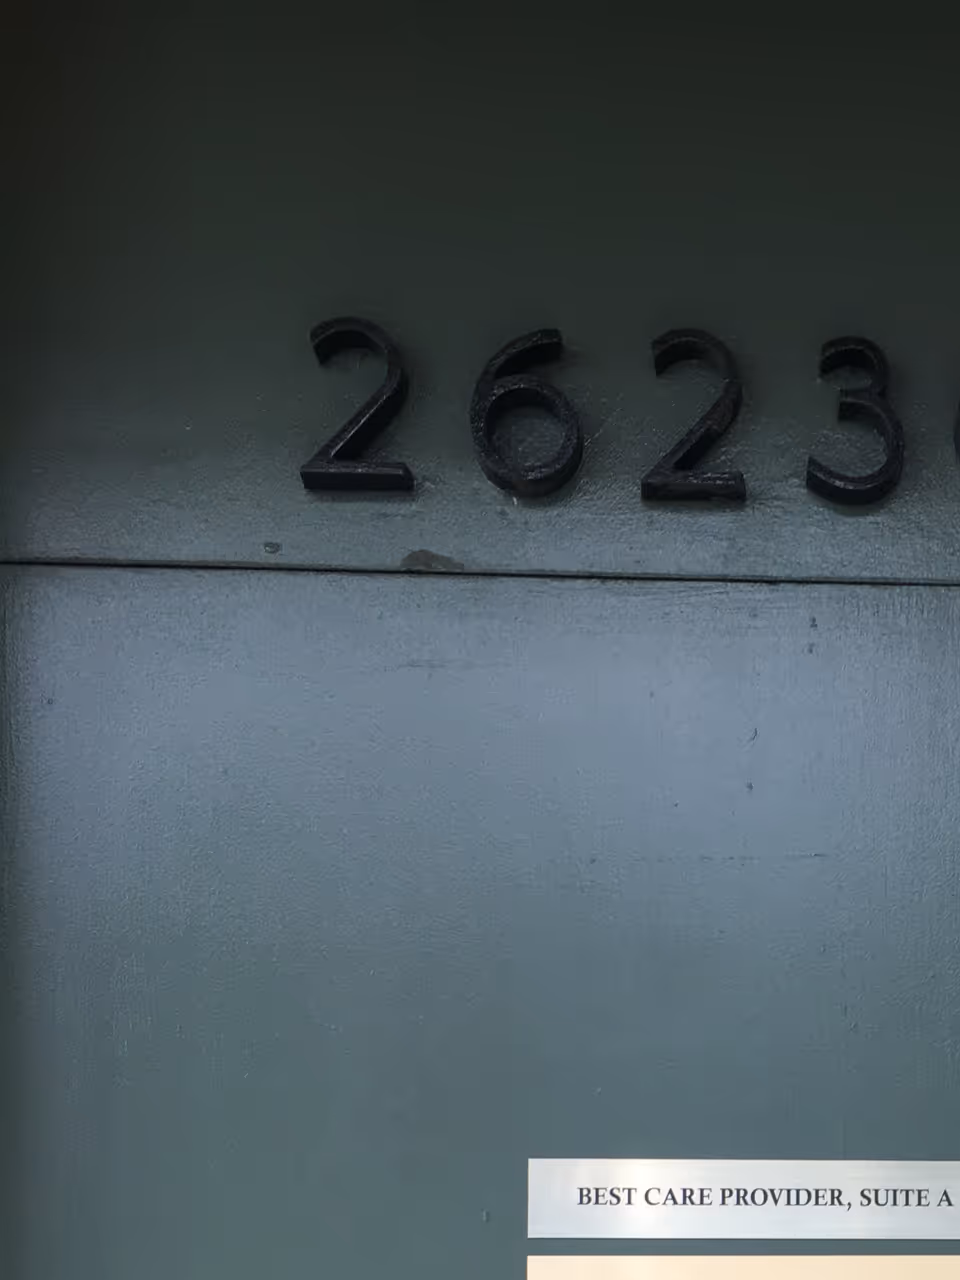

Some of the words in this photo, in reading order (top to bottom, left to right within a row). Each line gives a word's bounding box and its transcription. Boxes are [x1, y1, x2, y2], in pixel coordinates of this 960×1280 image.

[577, 1186, 638, 1206] BEST
[644, 1187, 713, 1207] CARE
[719, 1187, 852, 1211] PROVIDER,
[859, 1188, 930, 1208] SUITE
[937, 1189, 955, 1208] A
